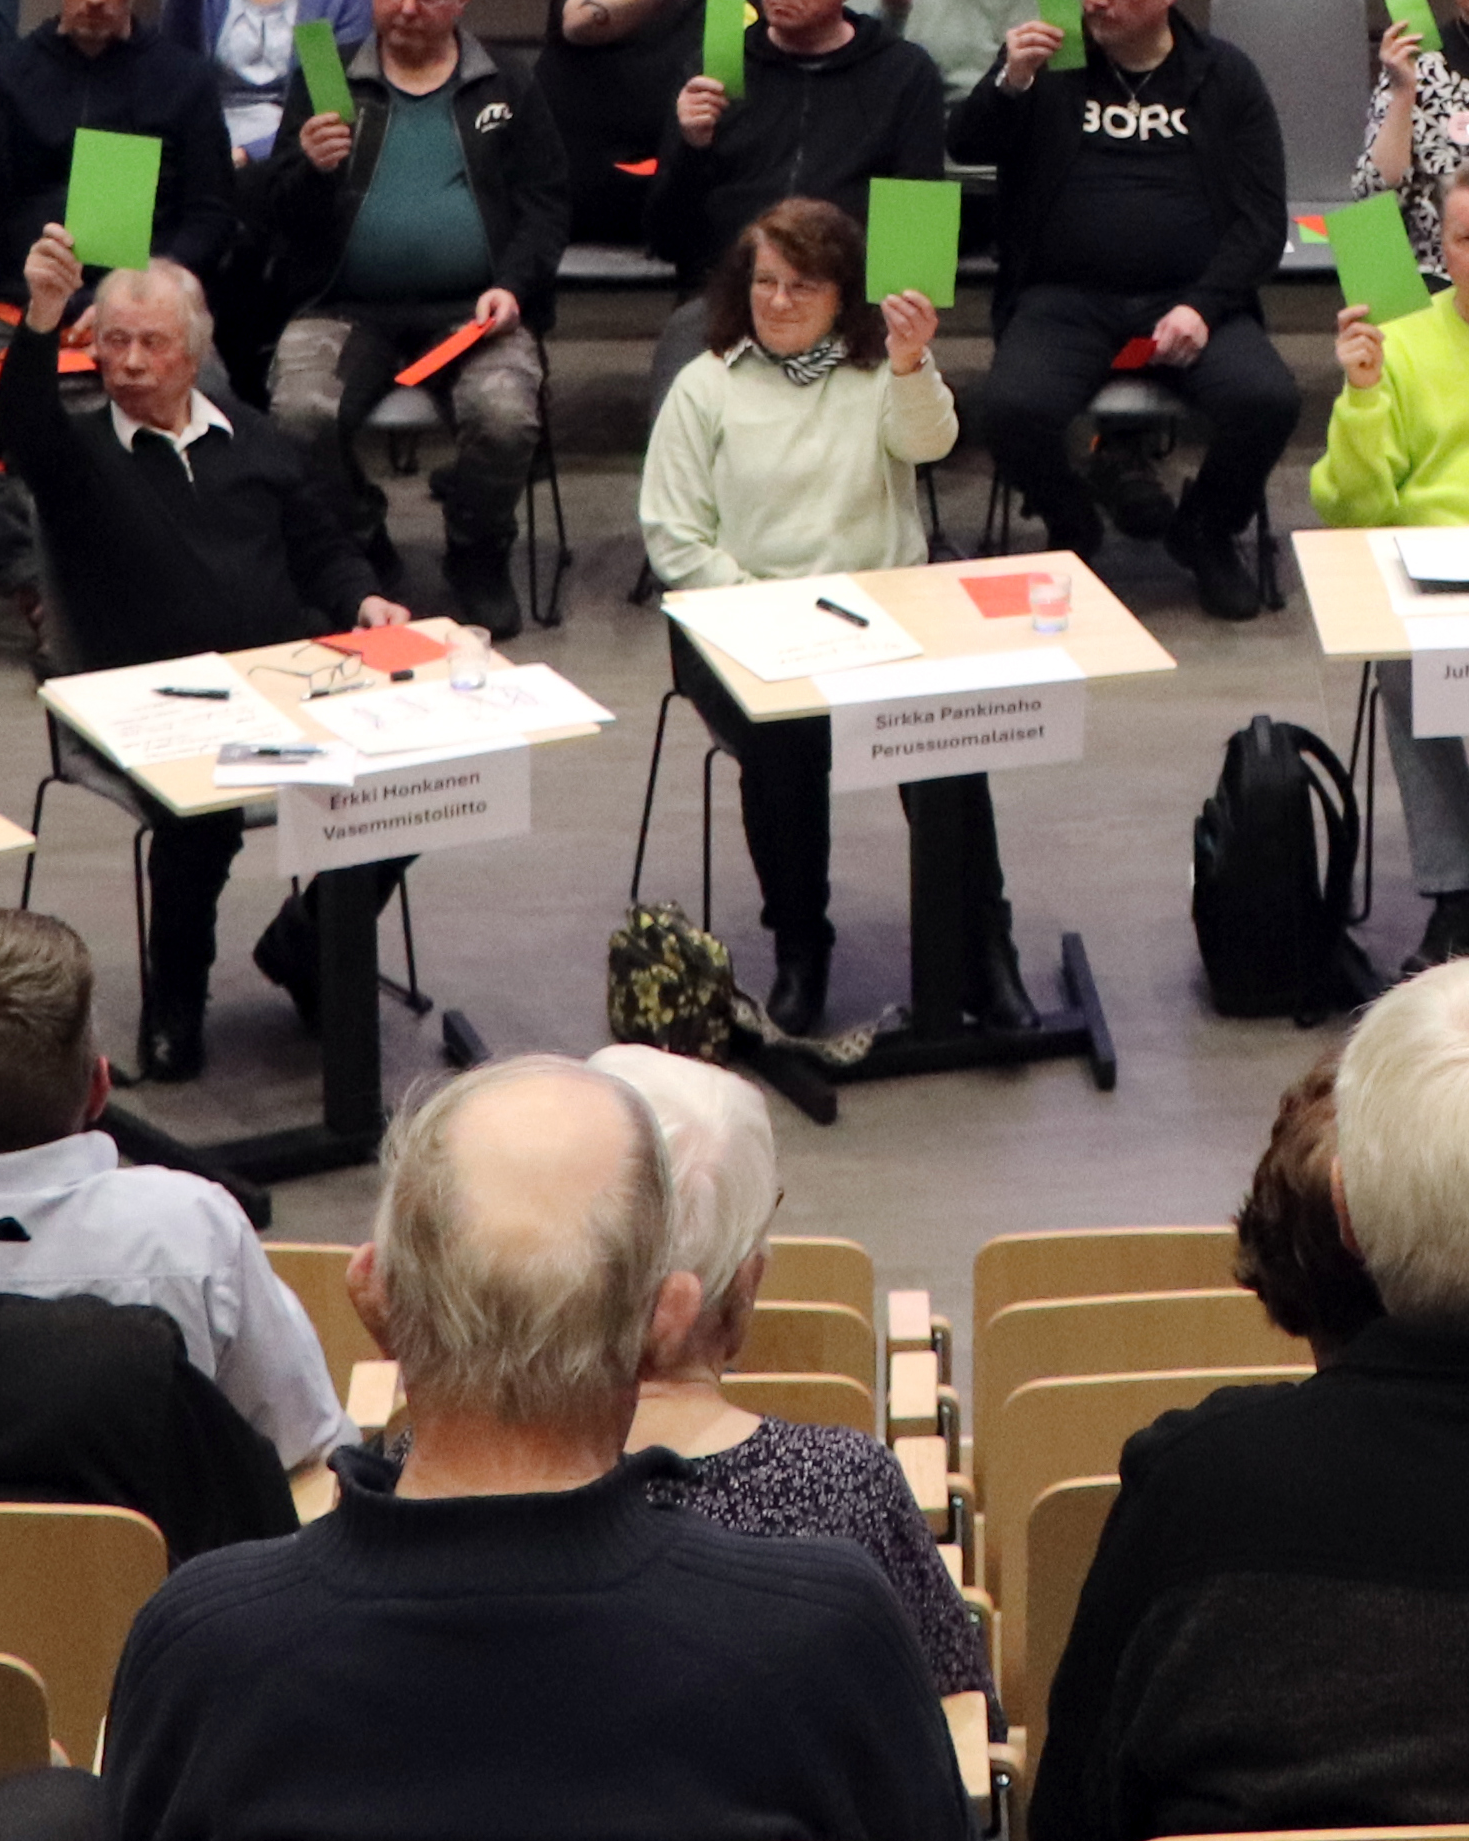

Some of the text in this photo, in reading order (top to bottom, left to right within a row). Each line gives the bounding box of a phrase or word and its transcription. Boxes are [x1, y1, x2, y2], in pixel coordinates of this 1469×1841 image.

[875, 698, 1042, 730] Sirkka Pankinaho
[871, 724, 1046, 760] Perussuomalaiset
[330, 771, 481, 811] Erkki Honkanen
[322, 799, 488, 842] Vasemmistoliitto
